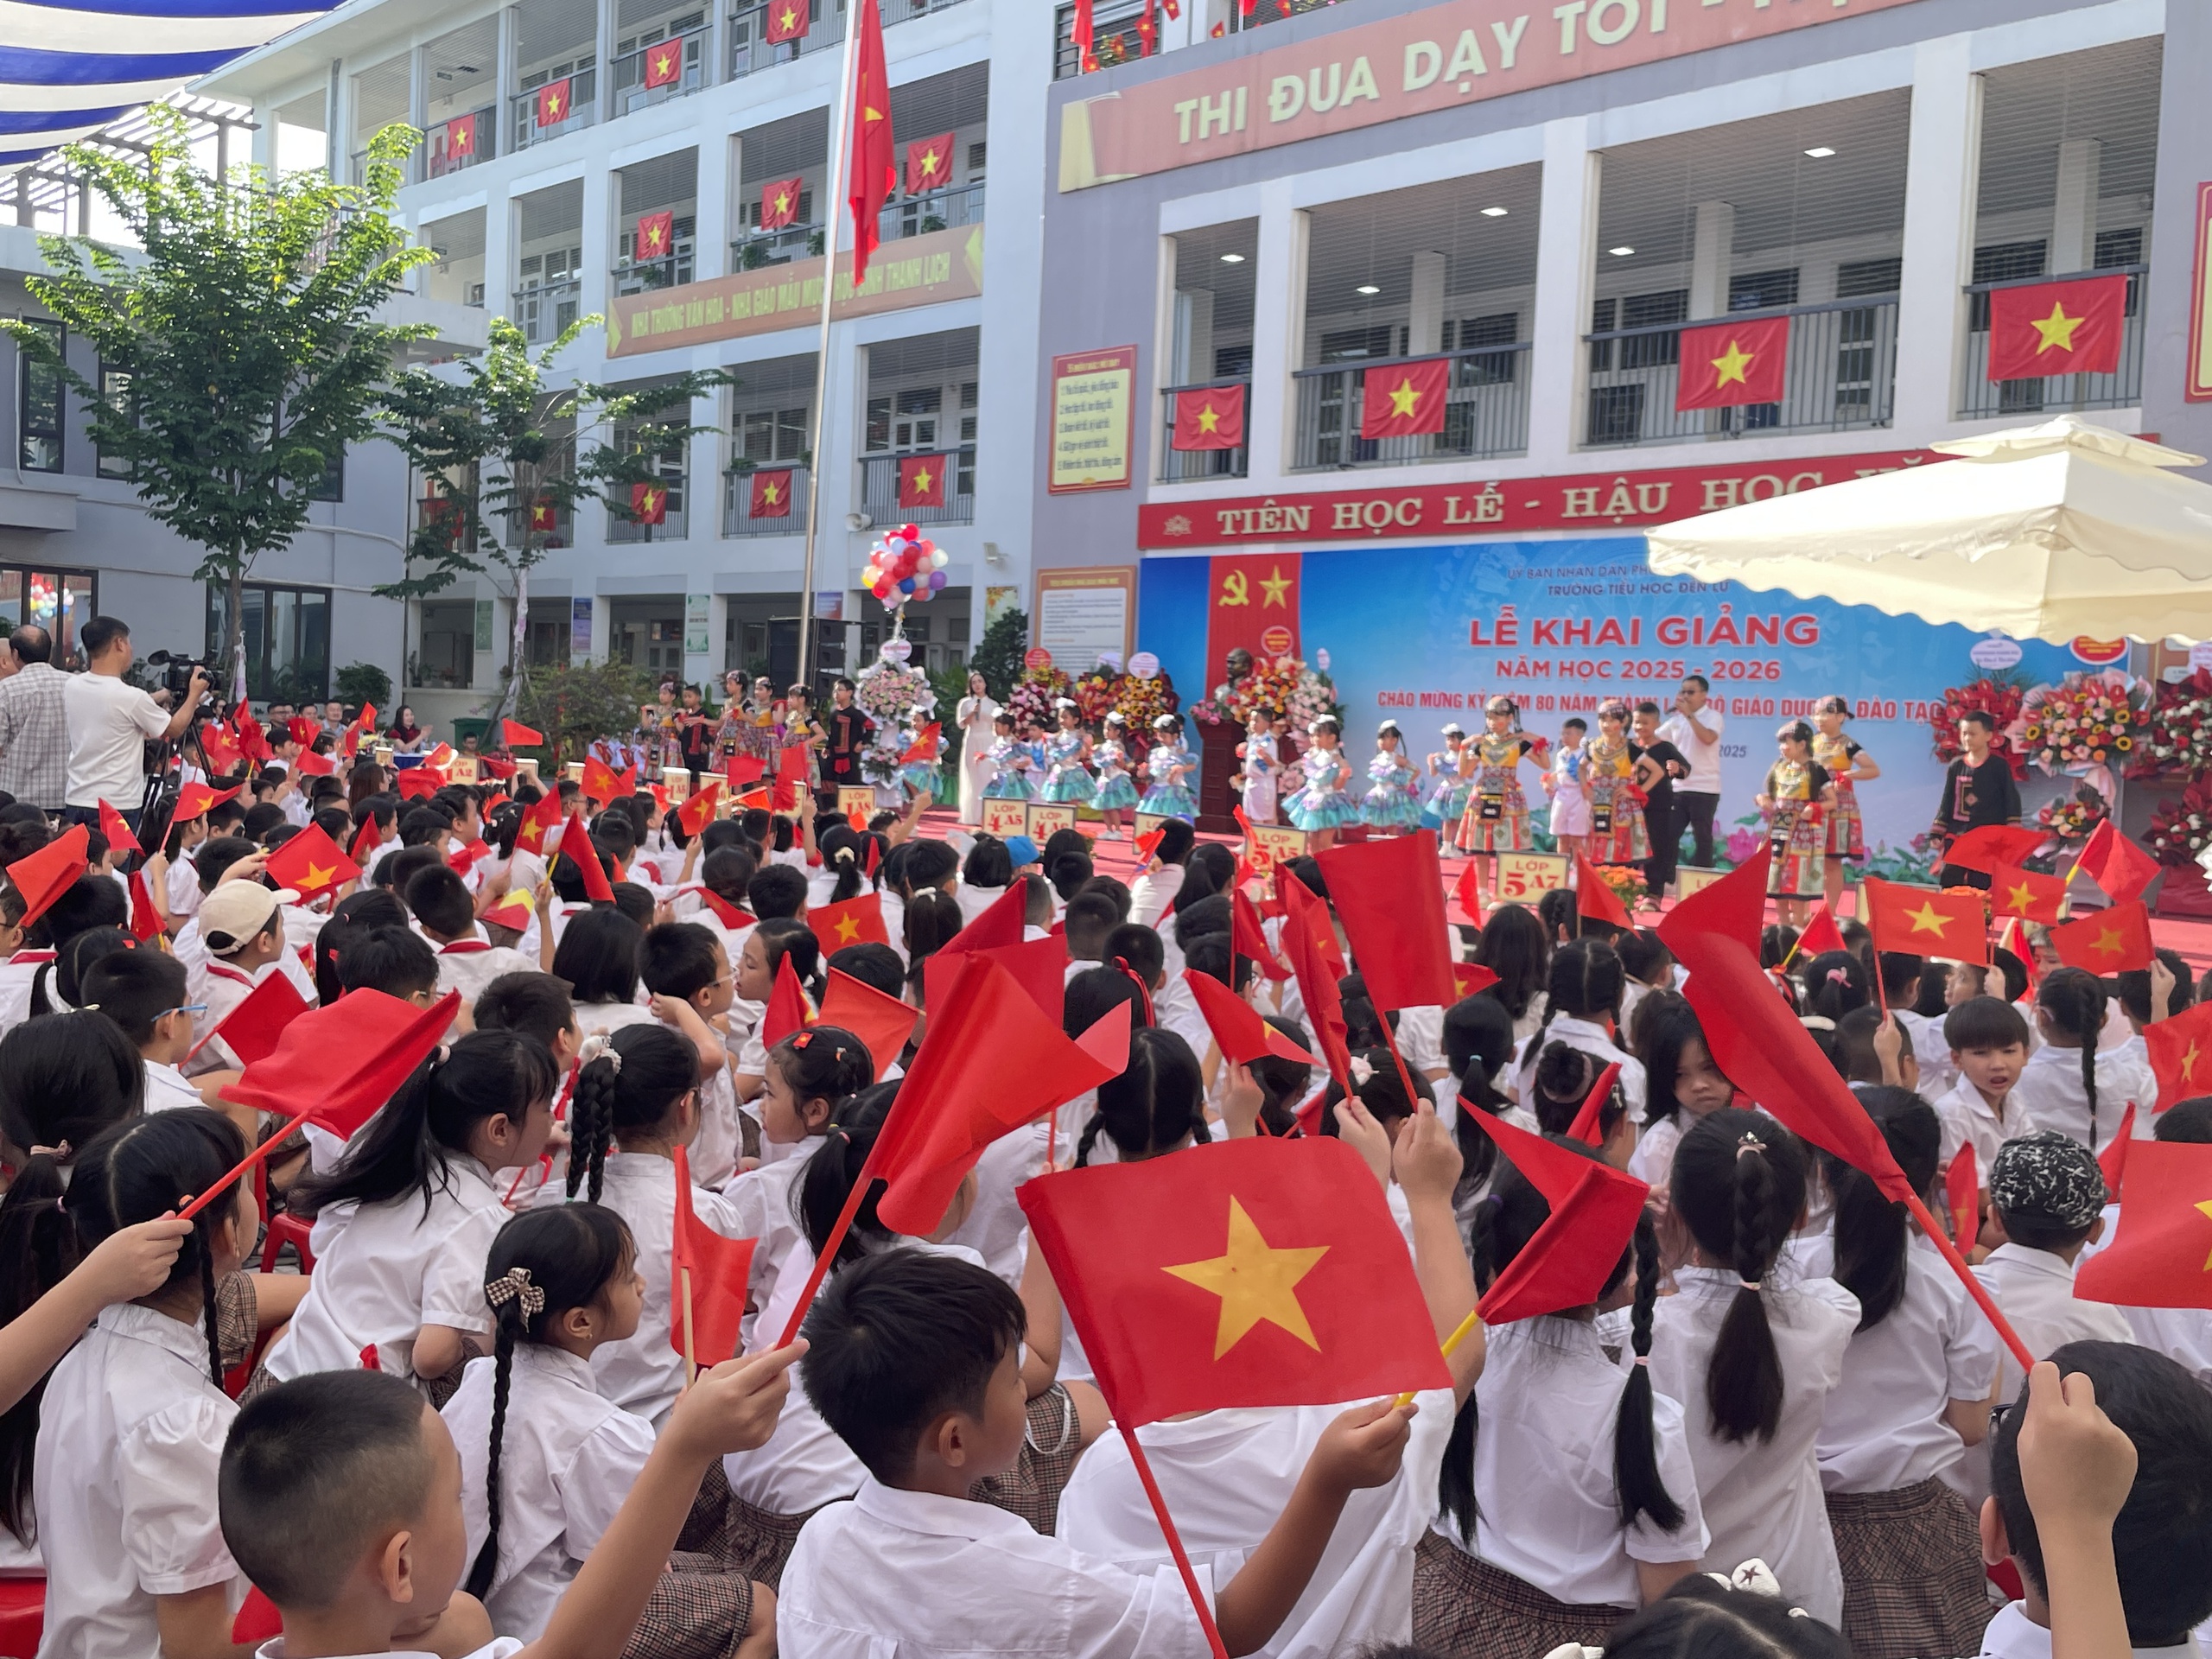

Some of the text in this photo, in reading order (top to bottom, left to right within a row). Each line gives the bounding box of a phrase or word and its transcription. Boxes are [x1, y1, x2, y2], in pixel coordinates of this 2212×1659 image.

[1174, 86, 1248, 144] THI
[1268, 56, 1380, 123] ĐUA
[1402, 15, 1530, 93] DẠY
[1217, 499, 1313, 536] TIÊN
[1331, 498, 1422, 534] HỌC
[1443, 481, 1504, 524] LỄ
[1561, 478, 1673, 524] HẬU
[1527, 568, 1553, 579] BAN
[1548, 582, 1604, 596] TRƯỜNG
[1640, 582, 1673, 596] HỌC
[1471, 605, 1820, 646] LỄ KHAI GIẢNG
[1496, 654, 1550, 678] NĂM
[1559, 660, 1612, 683] HỌC
[1621, 660, 1685, 679] 2025
[1711, 660, 1781, 680] 2026
[1377, 689, 1414, 707] CHÀO
[1420, 690, 1463, 709] MỪNG
[1535, 695, 1554, 711] 80
[1560, 692, 1597, 711] NĂM
[1732, 694, 1775, 716] GIÁO
[1856, 696, 1897, 719] ĐÀO
